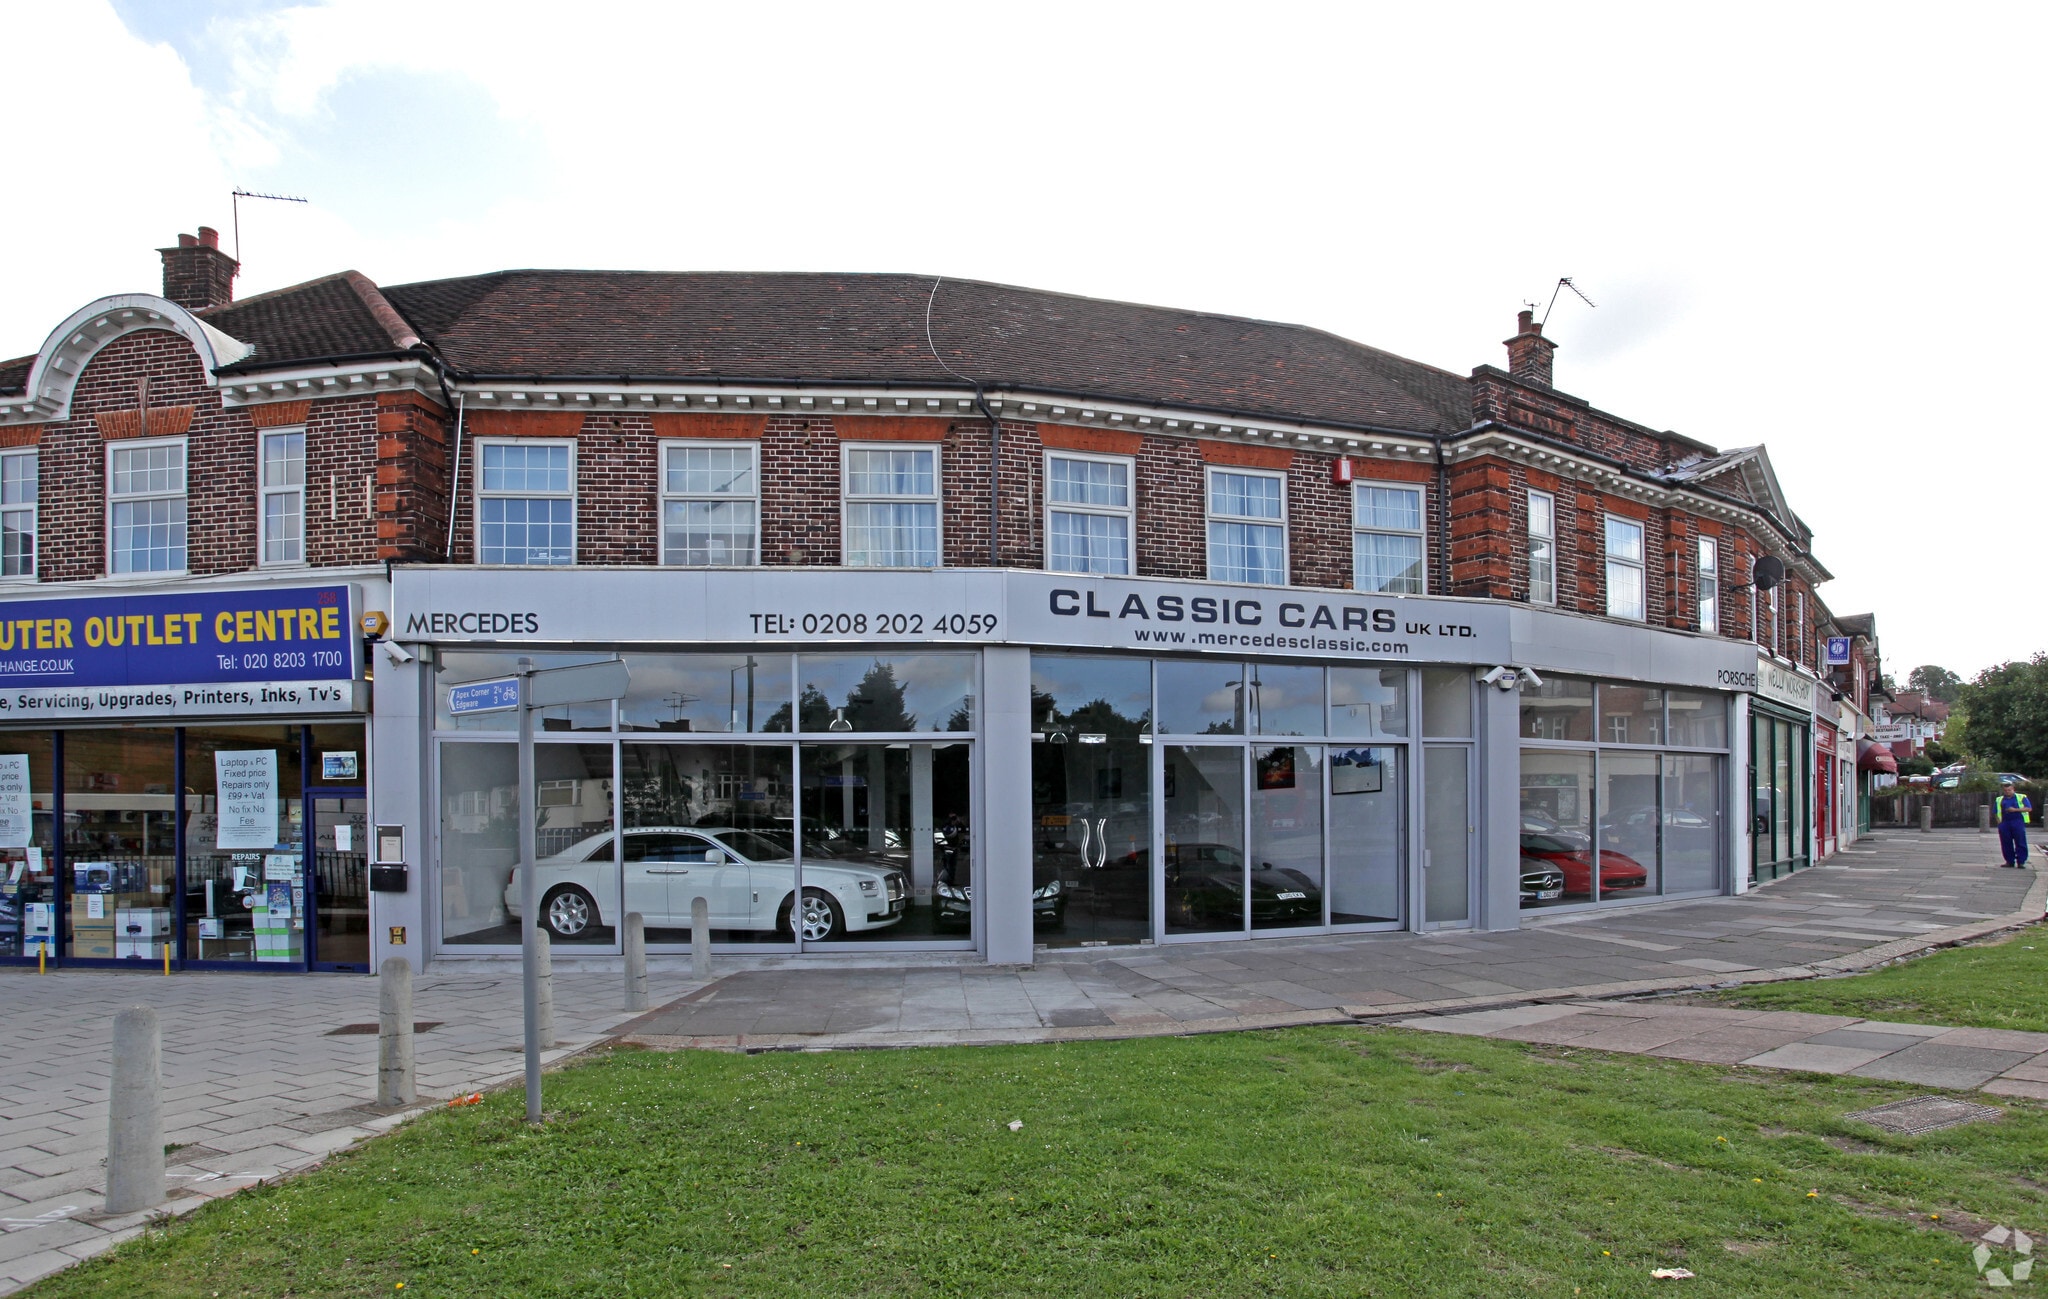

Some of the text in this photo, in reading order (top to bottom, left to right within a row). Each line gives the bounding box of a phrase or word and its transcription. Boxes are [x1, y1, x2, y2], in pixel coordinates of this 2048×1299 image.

[1049, 588, 1477, 638] CLASSIC CARS UK LTD.
[405, 611, 539, 634] MERCEDES
[750, 613, 999, 635] TEL: 0208 202 4059
[0, 607, 340, 651] UTER OUTLET CENTRE
[217, 650, 342, 670] Tel: 020 8203 1700
[1717, 669, 1756, 687] PORSCHE
[456, 690, 470, 699] Apex
[470, 687, 490, 697] Corner
[18, 694, 95, 713] Servicing,
[99, 691, 177, 710] Upgrades,
[183, 689, 254, 707] Printers,
[260, 687, 302, 704] Inks,
[456, 696, 499, 710] Edgware 3
[9, 761, 20, 769] PC
[220, 758, 248, 768] Laptop
[255, 757, 267, 766] PC
[2, 772, 19, 781] price
[224, 769, 267, 779] Fixed price
[6, 783, 23, 792] only
[221, 780, 270, 790] Repairs only
[251, 791, 265, 799] Vat
[8, 806, 18, 814] No
[228, 805, 265, 814] No fix No
[239, 816, 255, 825] Fee
[231, 853, 261, 861] REPAIRS
